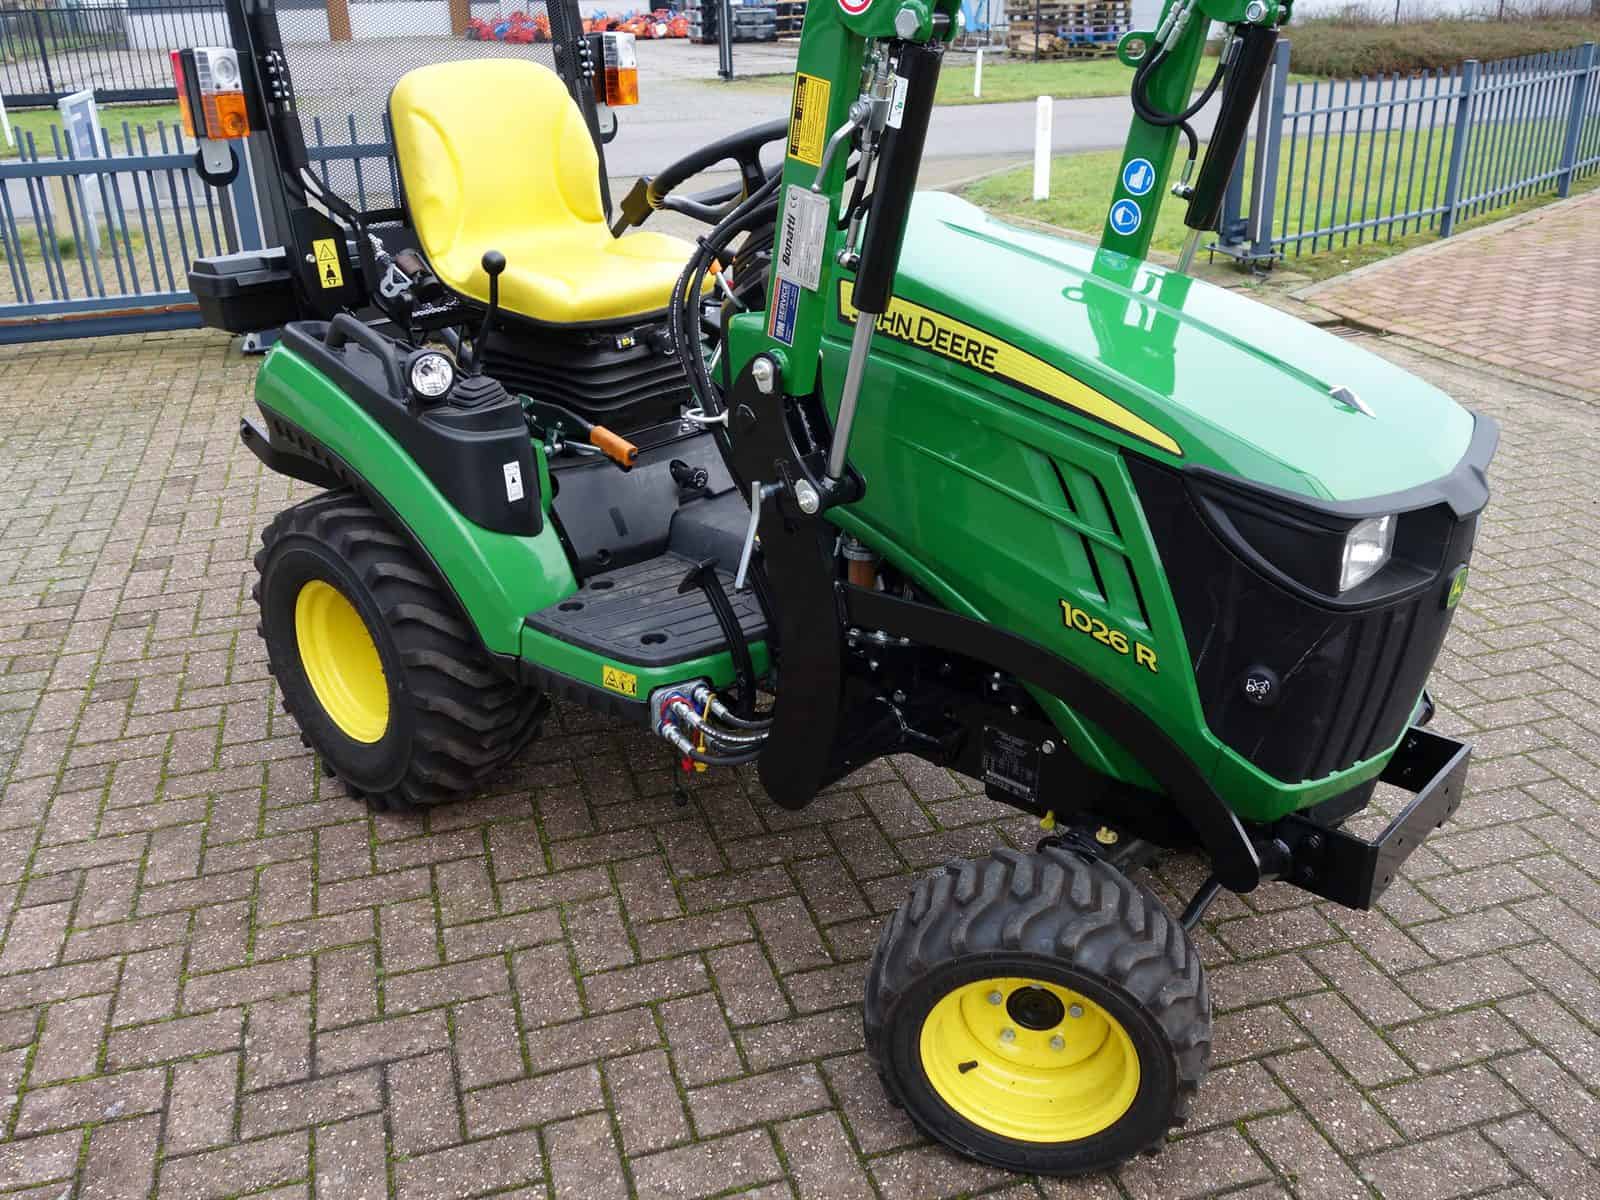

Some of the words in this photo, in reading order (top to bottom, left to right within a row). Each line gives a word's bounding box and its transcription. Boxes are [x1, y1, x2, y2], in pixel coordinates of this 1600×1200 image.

[782, 215, 796, 266] Bonatti
[917, 317, 998, 370] DEERE
[1060, 599, 1129, 655] 1026
[1135, 642, 1158, 673] R
